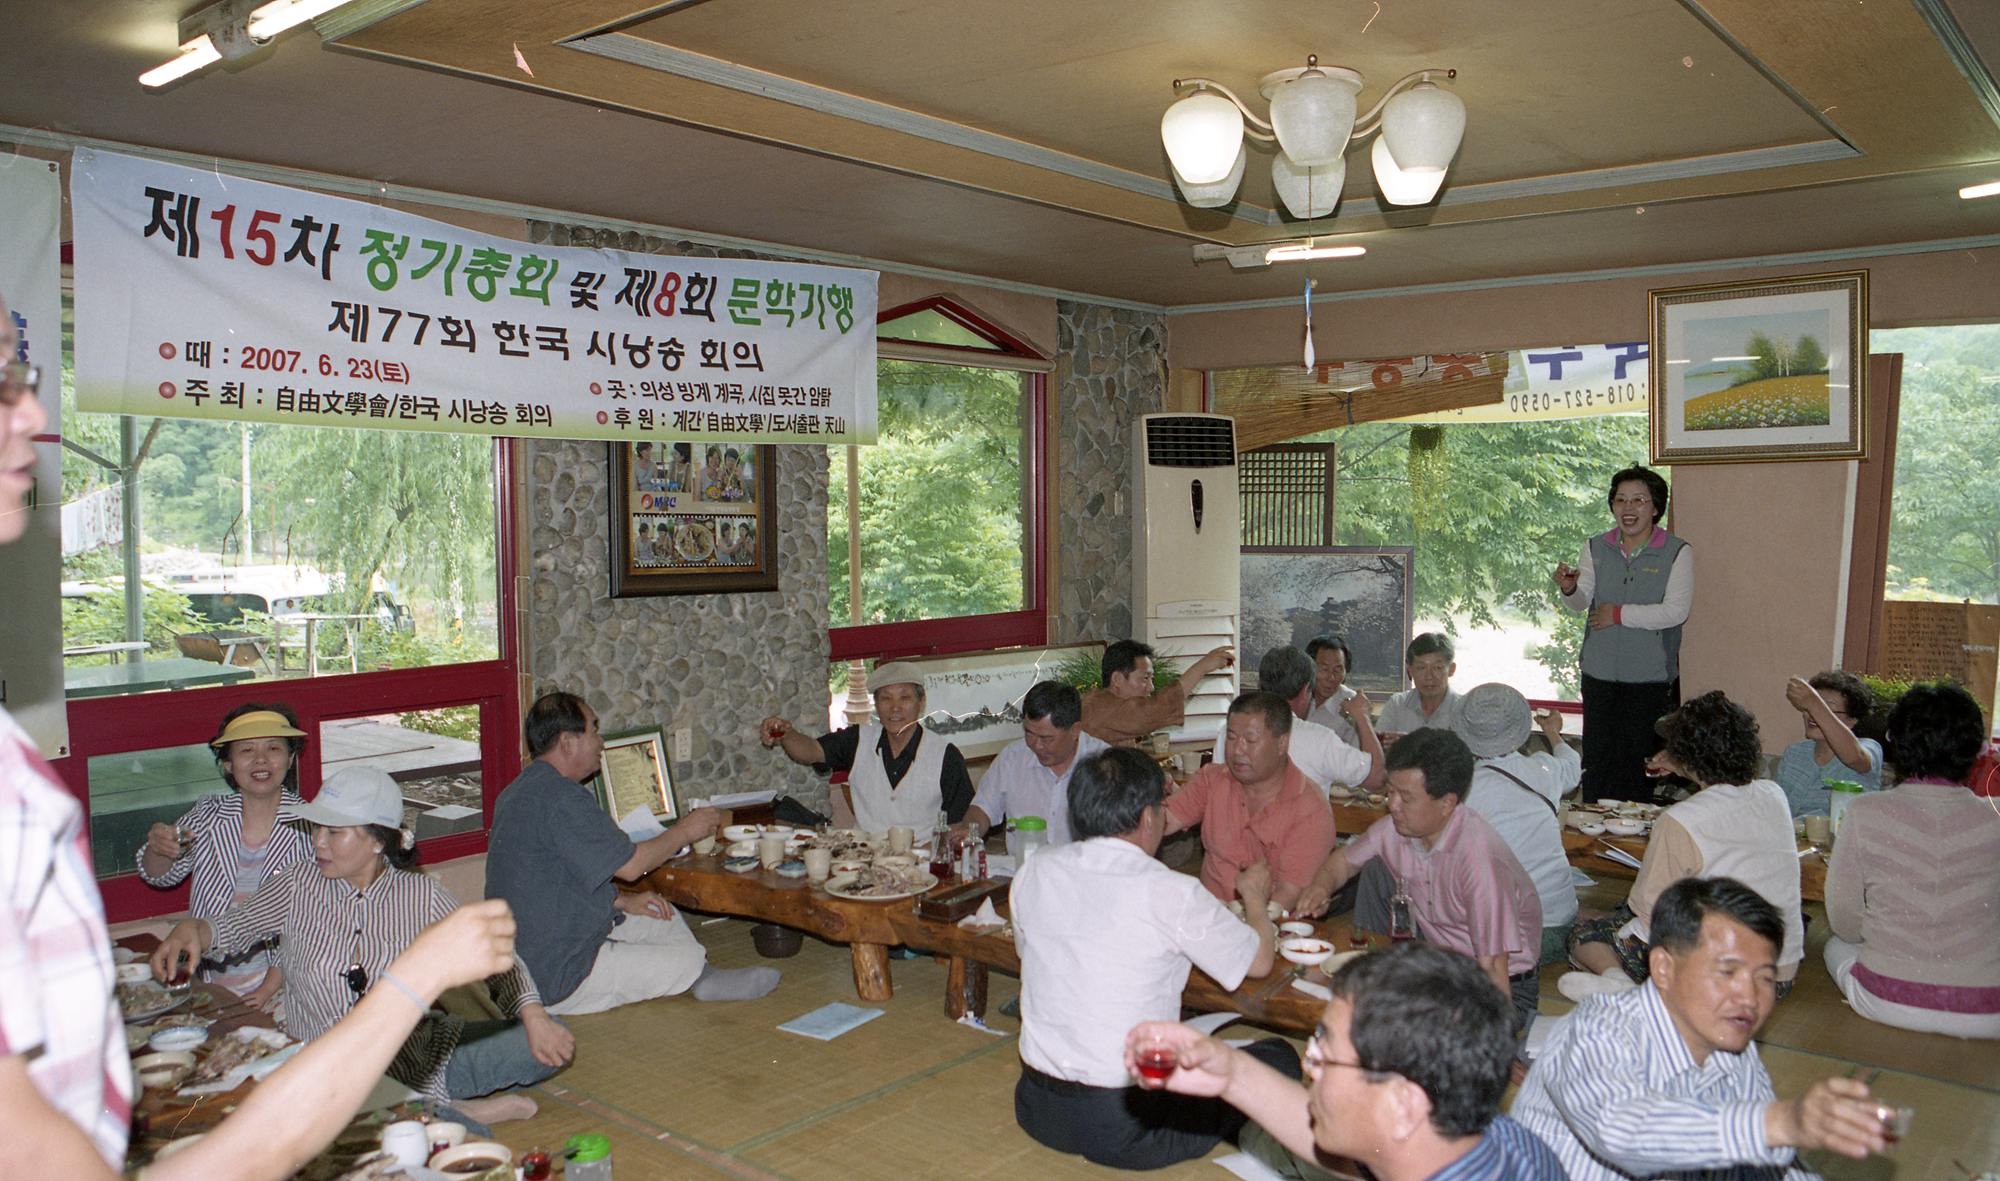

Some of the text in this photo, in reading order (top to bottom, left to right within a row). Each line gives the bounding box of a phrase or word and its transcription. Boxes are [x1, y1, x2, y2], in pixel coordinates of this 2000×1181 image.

[144, 186, 854, 334] 제15차 정기총회 및 제8회 문학기행
[328, 301, 764, 372] 제77회 한국 시낭송 회의
[185, 341, 211, 369] 때
[241, 346, 307, 374] 2007.
[318, 354, 339, 376] 6.
[347, 357, 410, 385] 23(토)
[607, 380, 627, 399] 곳
[640, 381, 675, 401] 의성
[677, 383, 712, 403] 빙계
[714, 383, 745, 405] 계곡,
[748, 385, 776, 406] 시집
[778, 387, 807, 406] 못간
[809, 387, 832, 408] 암탉
[448, 399, 508, 425] 시낭송
[515, 403, 552, 427] 회의
[824, 416, 846, 435] 天山
